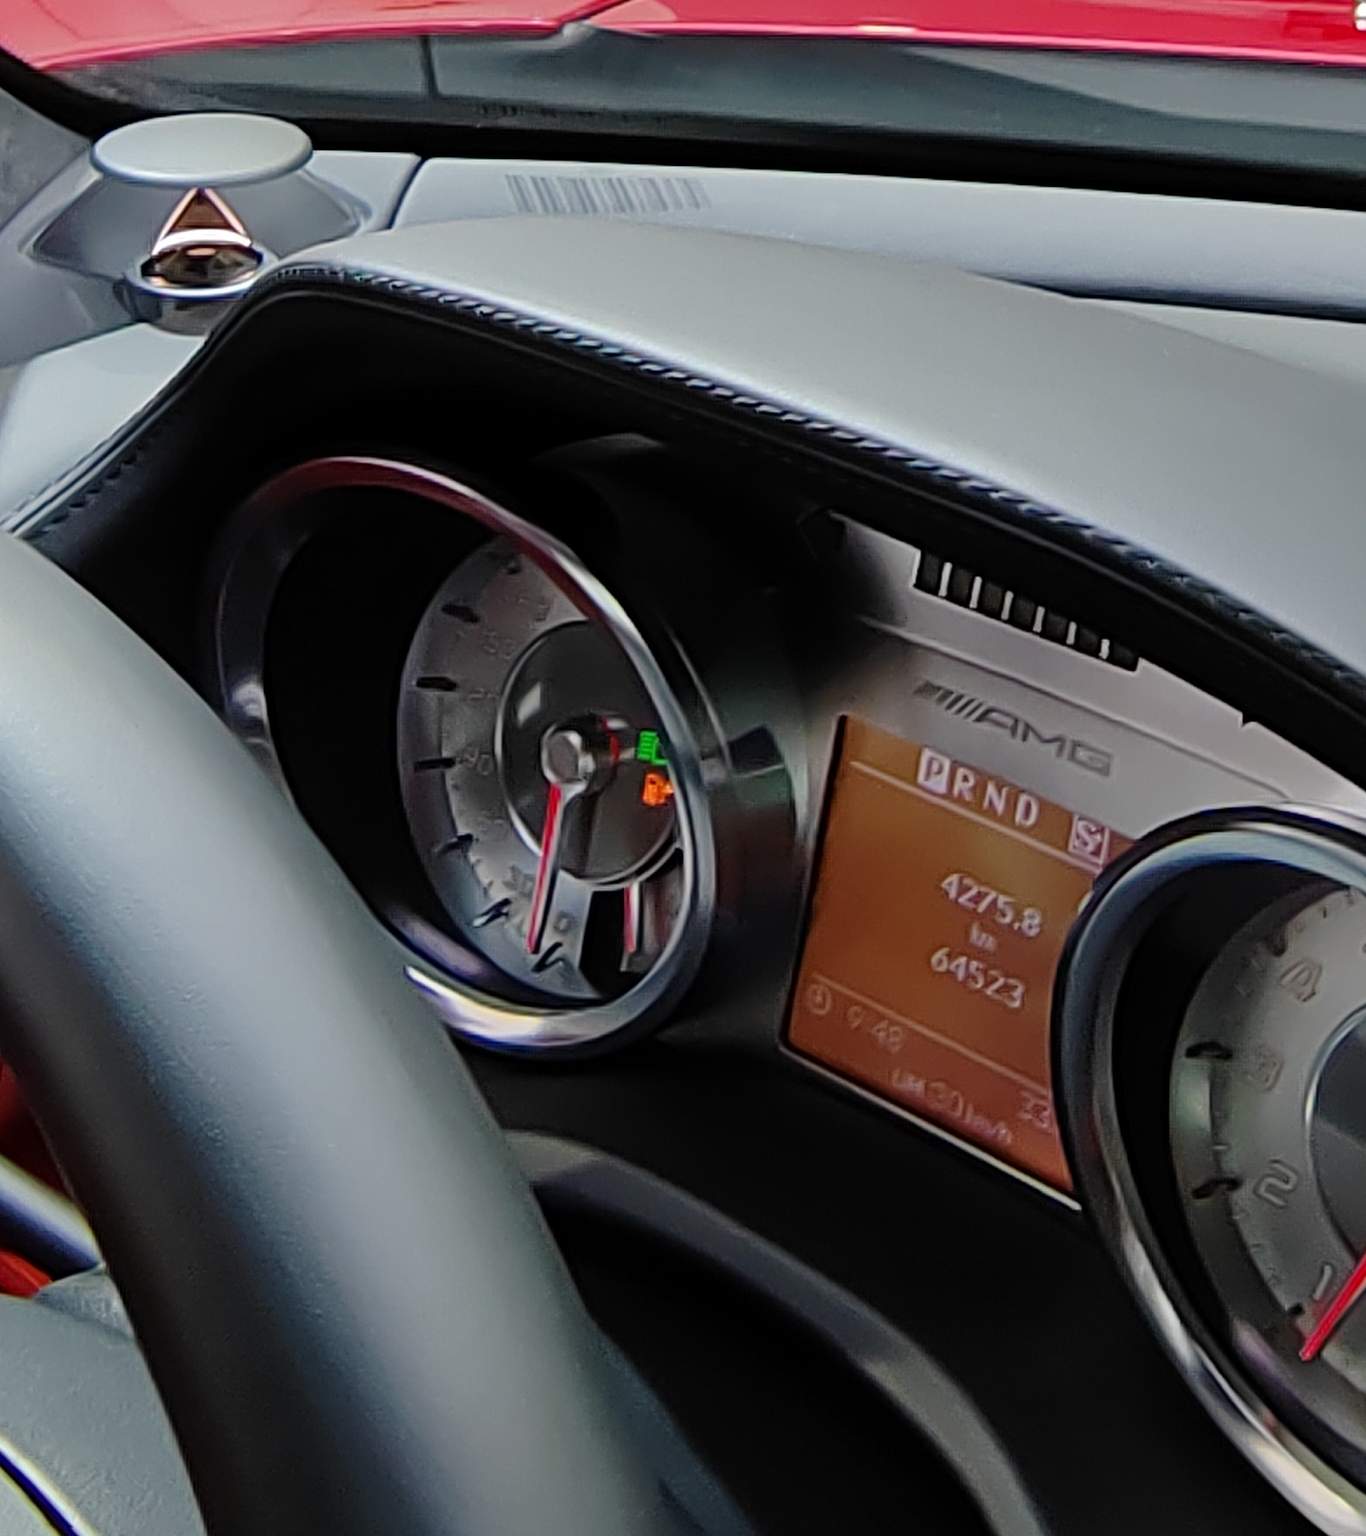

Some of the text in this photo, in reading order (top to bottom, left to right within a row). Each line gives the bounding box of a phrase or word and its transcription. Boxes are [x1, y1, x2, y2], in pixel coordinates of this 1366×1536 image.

[975, 706, 1115, 778] AMG
[953, 766, 976, 802] R
[983, 779, 1010, 817] N
[1013, 791, 1041, 828] D
[941, 873, 1042, 938] 4275.8
[930, 947, 1026, 1009] 64523
[1254, 1158, 1298, 1207] 2
